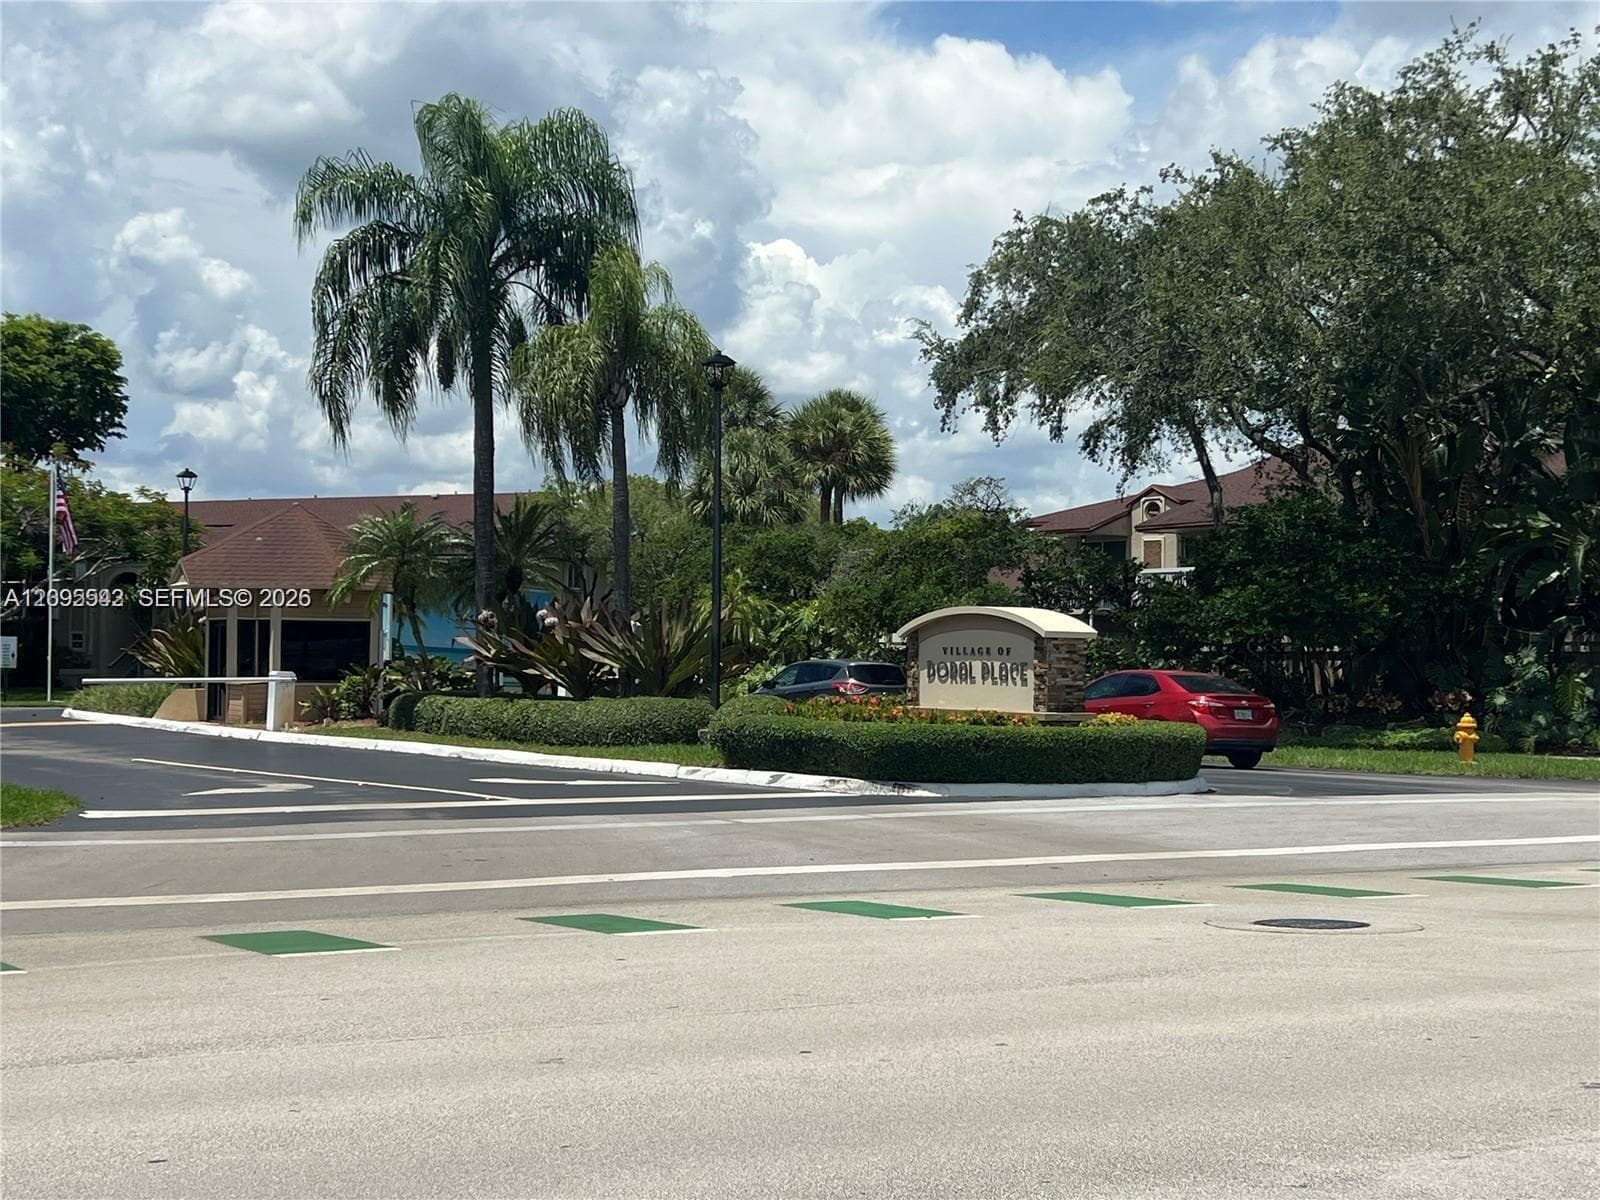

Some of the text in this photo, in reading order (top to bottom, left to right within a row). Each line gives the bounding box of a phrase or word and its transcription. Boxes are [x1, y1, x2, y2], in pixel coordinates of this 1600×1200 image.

[942, 646, 1012, 656] VILLAGE OF
[927, 660, 1029, 688] DORAL PLACE
